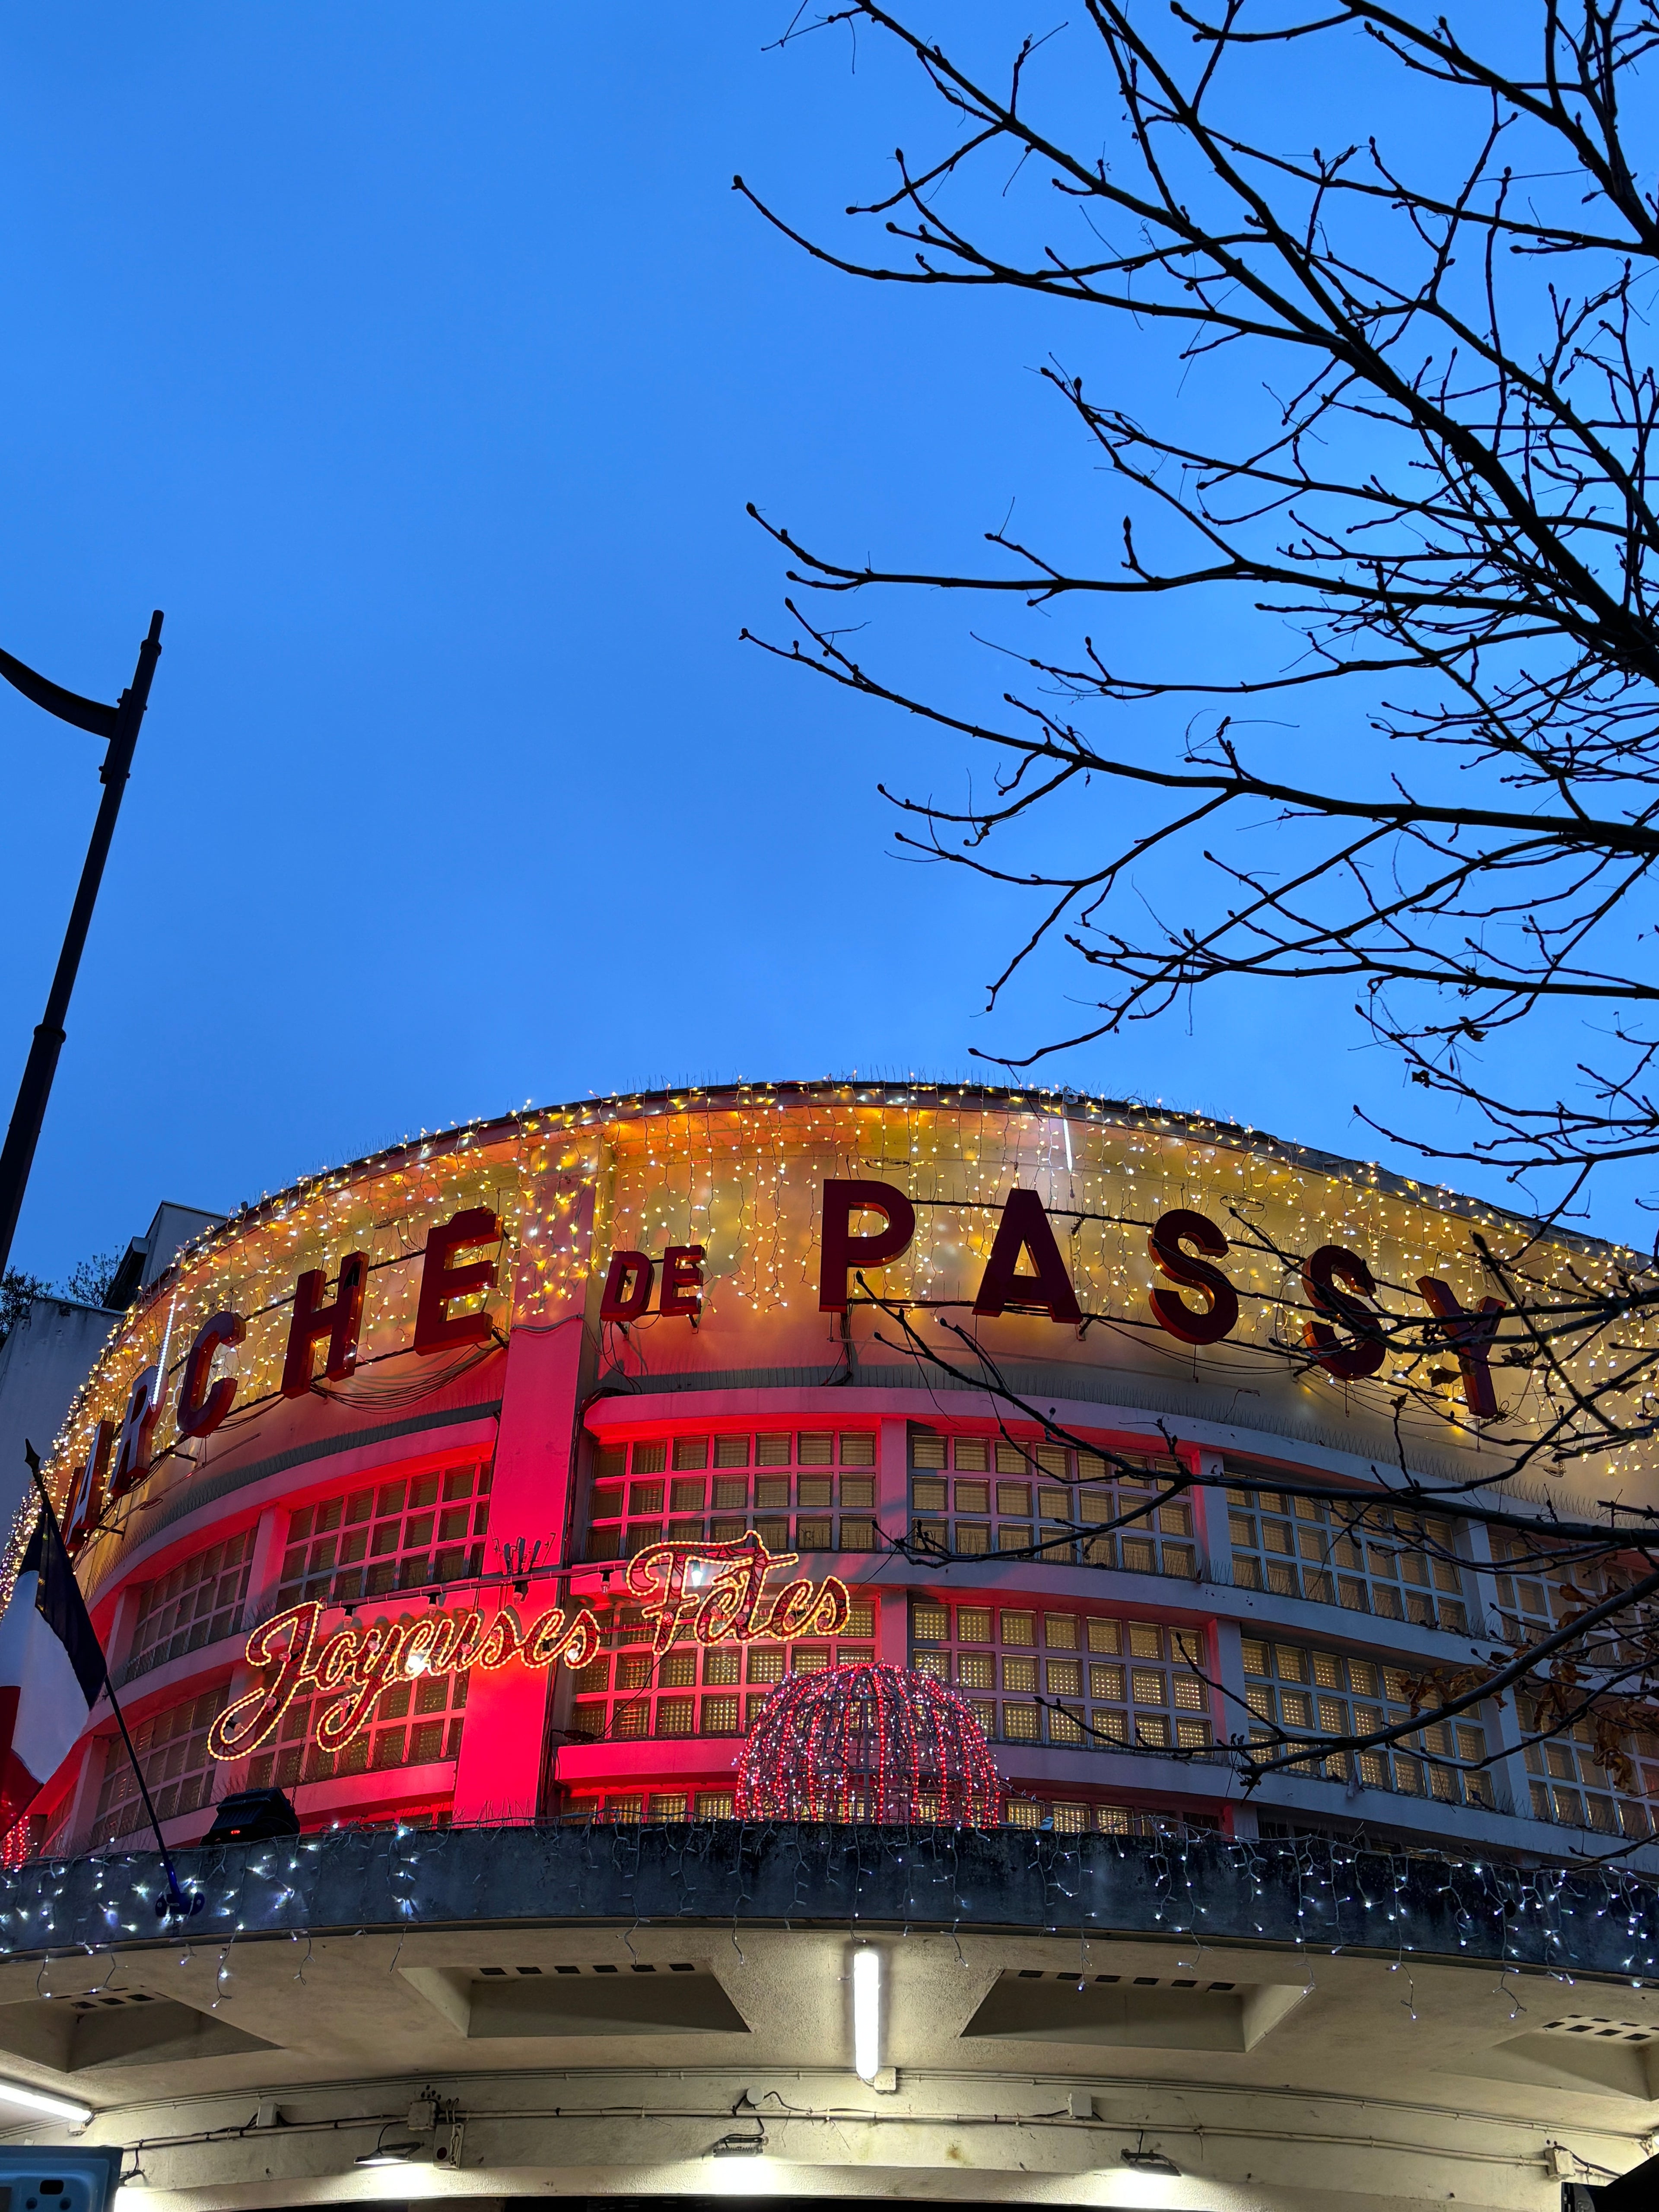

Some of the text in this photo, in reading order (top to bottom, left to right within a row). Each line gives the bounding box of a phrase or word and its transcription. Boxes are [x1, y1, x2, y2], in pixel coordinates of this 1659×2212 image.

[600, 1244, 706, 1322] DE
[818, 1179, 1507, 1418] PASSY
[207, 1600, 601, 1761] Joyeuses
